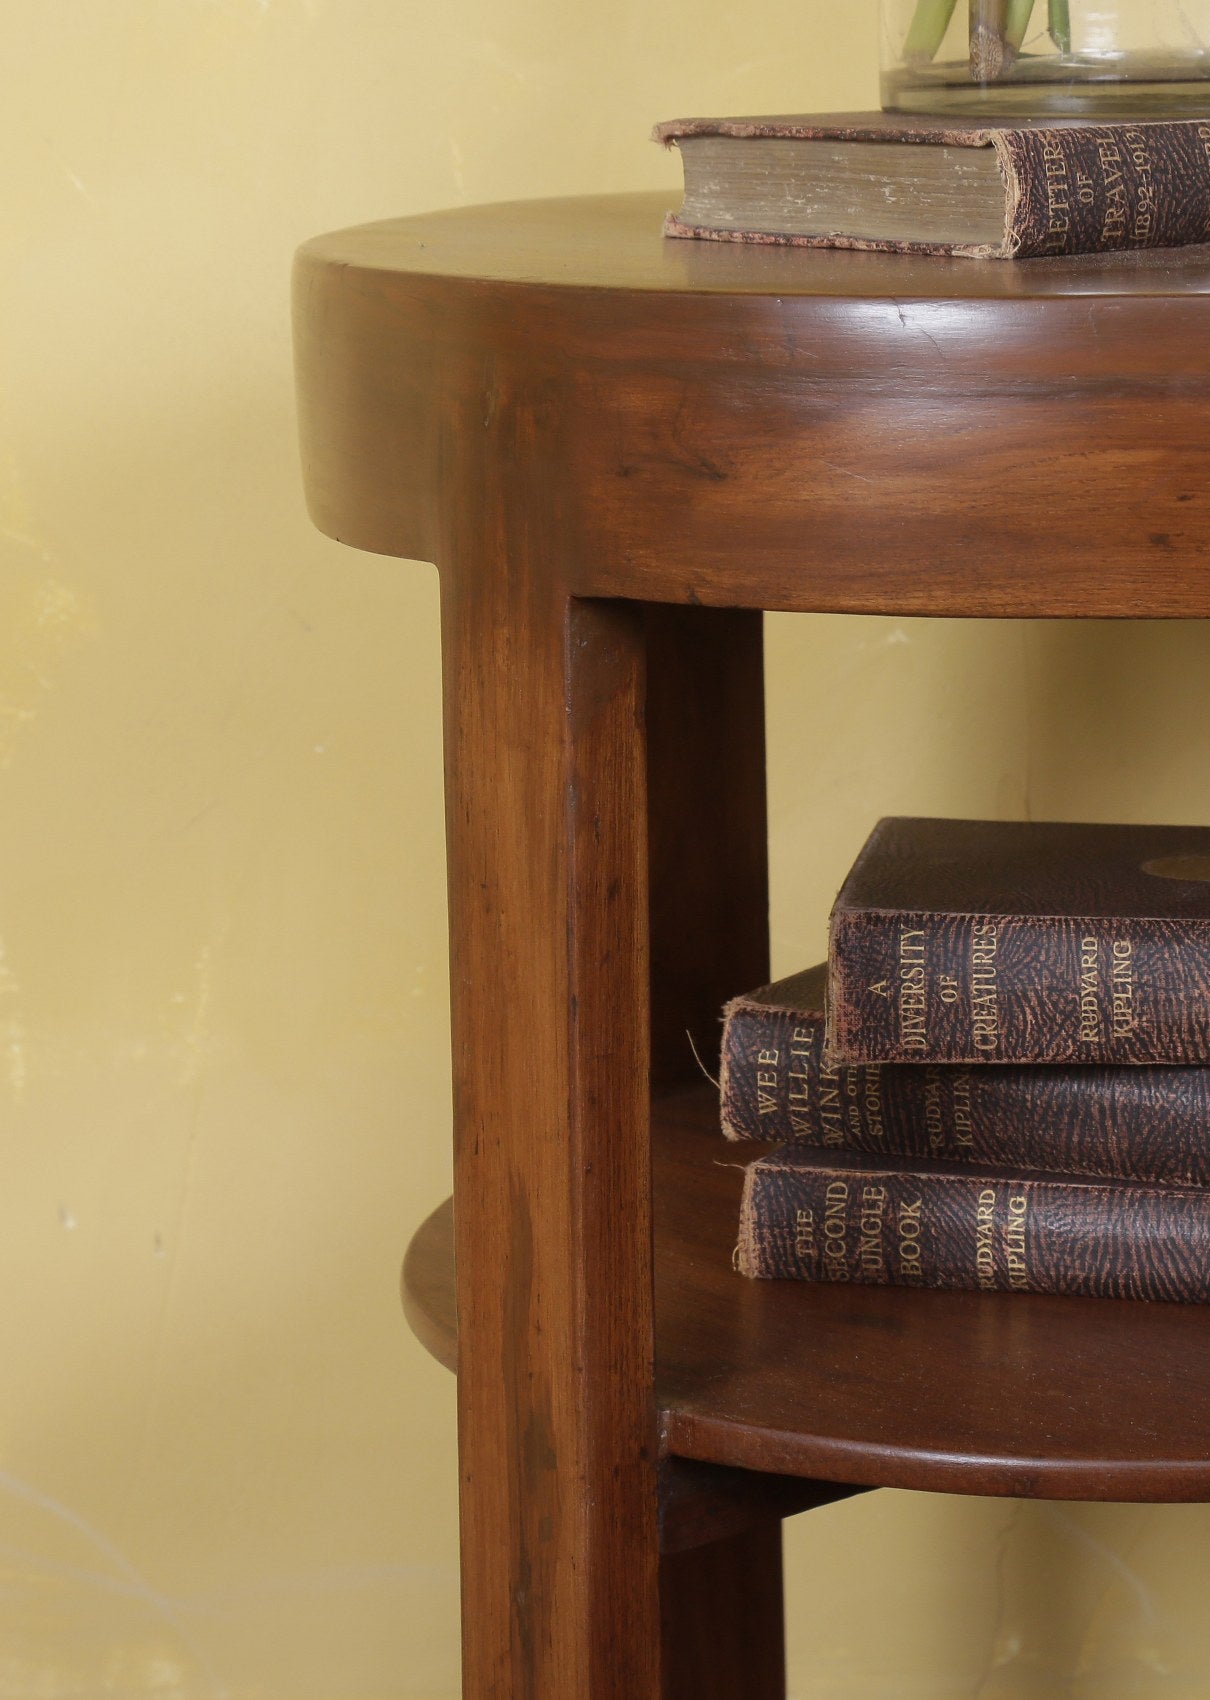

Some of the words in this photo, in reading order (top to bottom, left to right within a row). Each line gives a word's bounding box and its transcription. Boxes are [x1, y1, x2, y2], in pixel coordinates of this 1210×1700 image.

[1077, 172, 1094, 206] OF
[1098, 133, 1126, 242] TRAVEL
[867, 980, 889, 997] A
[900, 924, 926, 1050] DIVERSITY
[941, 975, 958, 1003] OF
[972, 925, 998, 1050] CREATURES
[1080, 936, 1099, 1042] RUDYARD
[1113, 940, 1132, 1038] KIPLING
[757, 1048, 779, 1115] WEE
[789, 1027, 814, 1137] WILLIE
[819, 1061, 844, 1146] WINK
[847, 1063, 858, 1096] OTH
[850, 1106, 863, 1137] AND
[865, 1063, 884, 1137] STORIE
[926, 1065, 945, 1149] RUDYAR
[954, 1065, 974, 1146] KIPLIN
[796, 1209, 814, 1257] THE
[824, 1181, 849, 1281] SECOND
[899, 1198, 922, 1276] BOOK
[976, 1189, 997, 1289] RUDYARD
[1007, 1196, 1028, 1289] KIPLING
